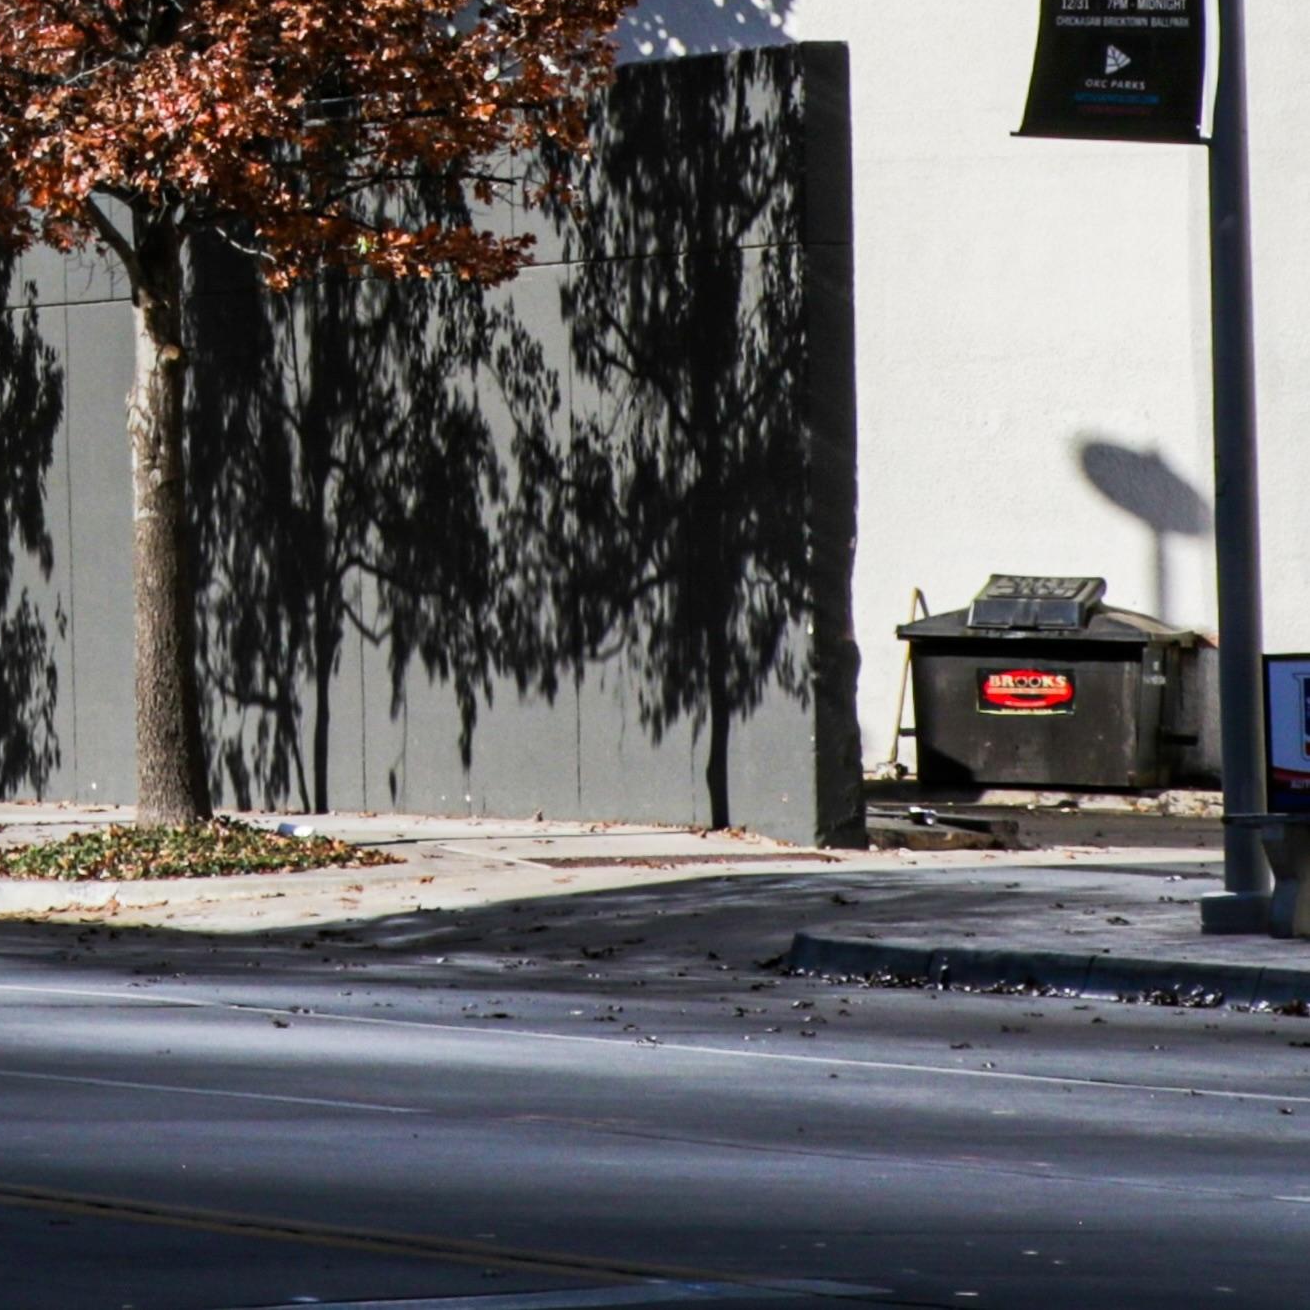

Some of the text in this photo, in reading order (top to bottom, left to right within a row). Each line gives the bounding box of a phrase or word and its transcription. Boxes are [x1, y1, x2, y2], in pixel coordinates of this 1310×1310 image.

[1085, 78, 1146, 91] OKC PARKS
[988, 674, 1067, 689] BROOKS
